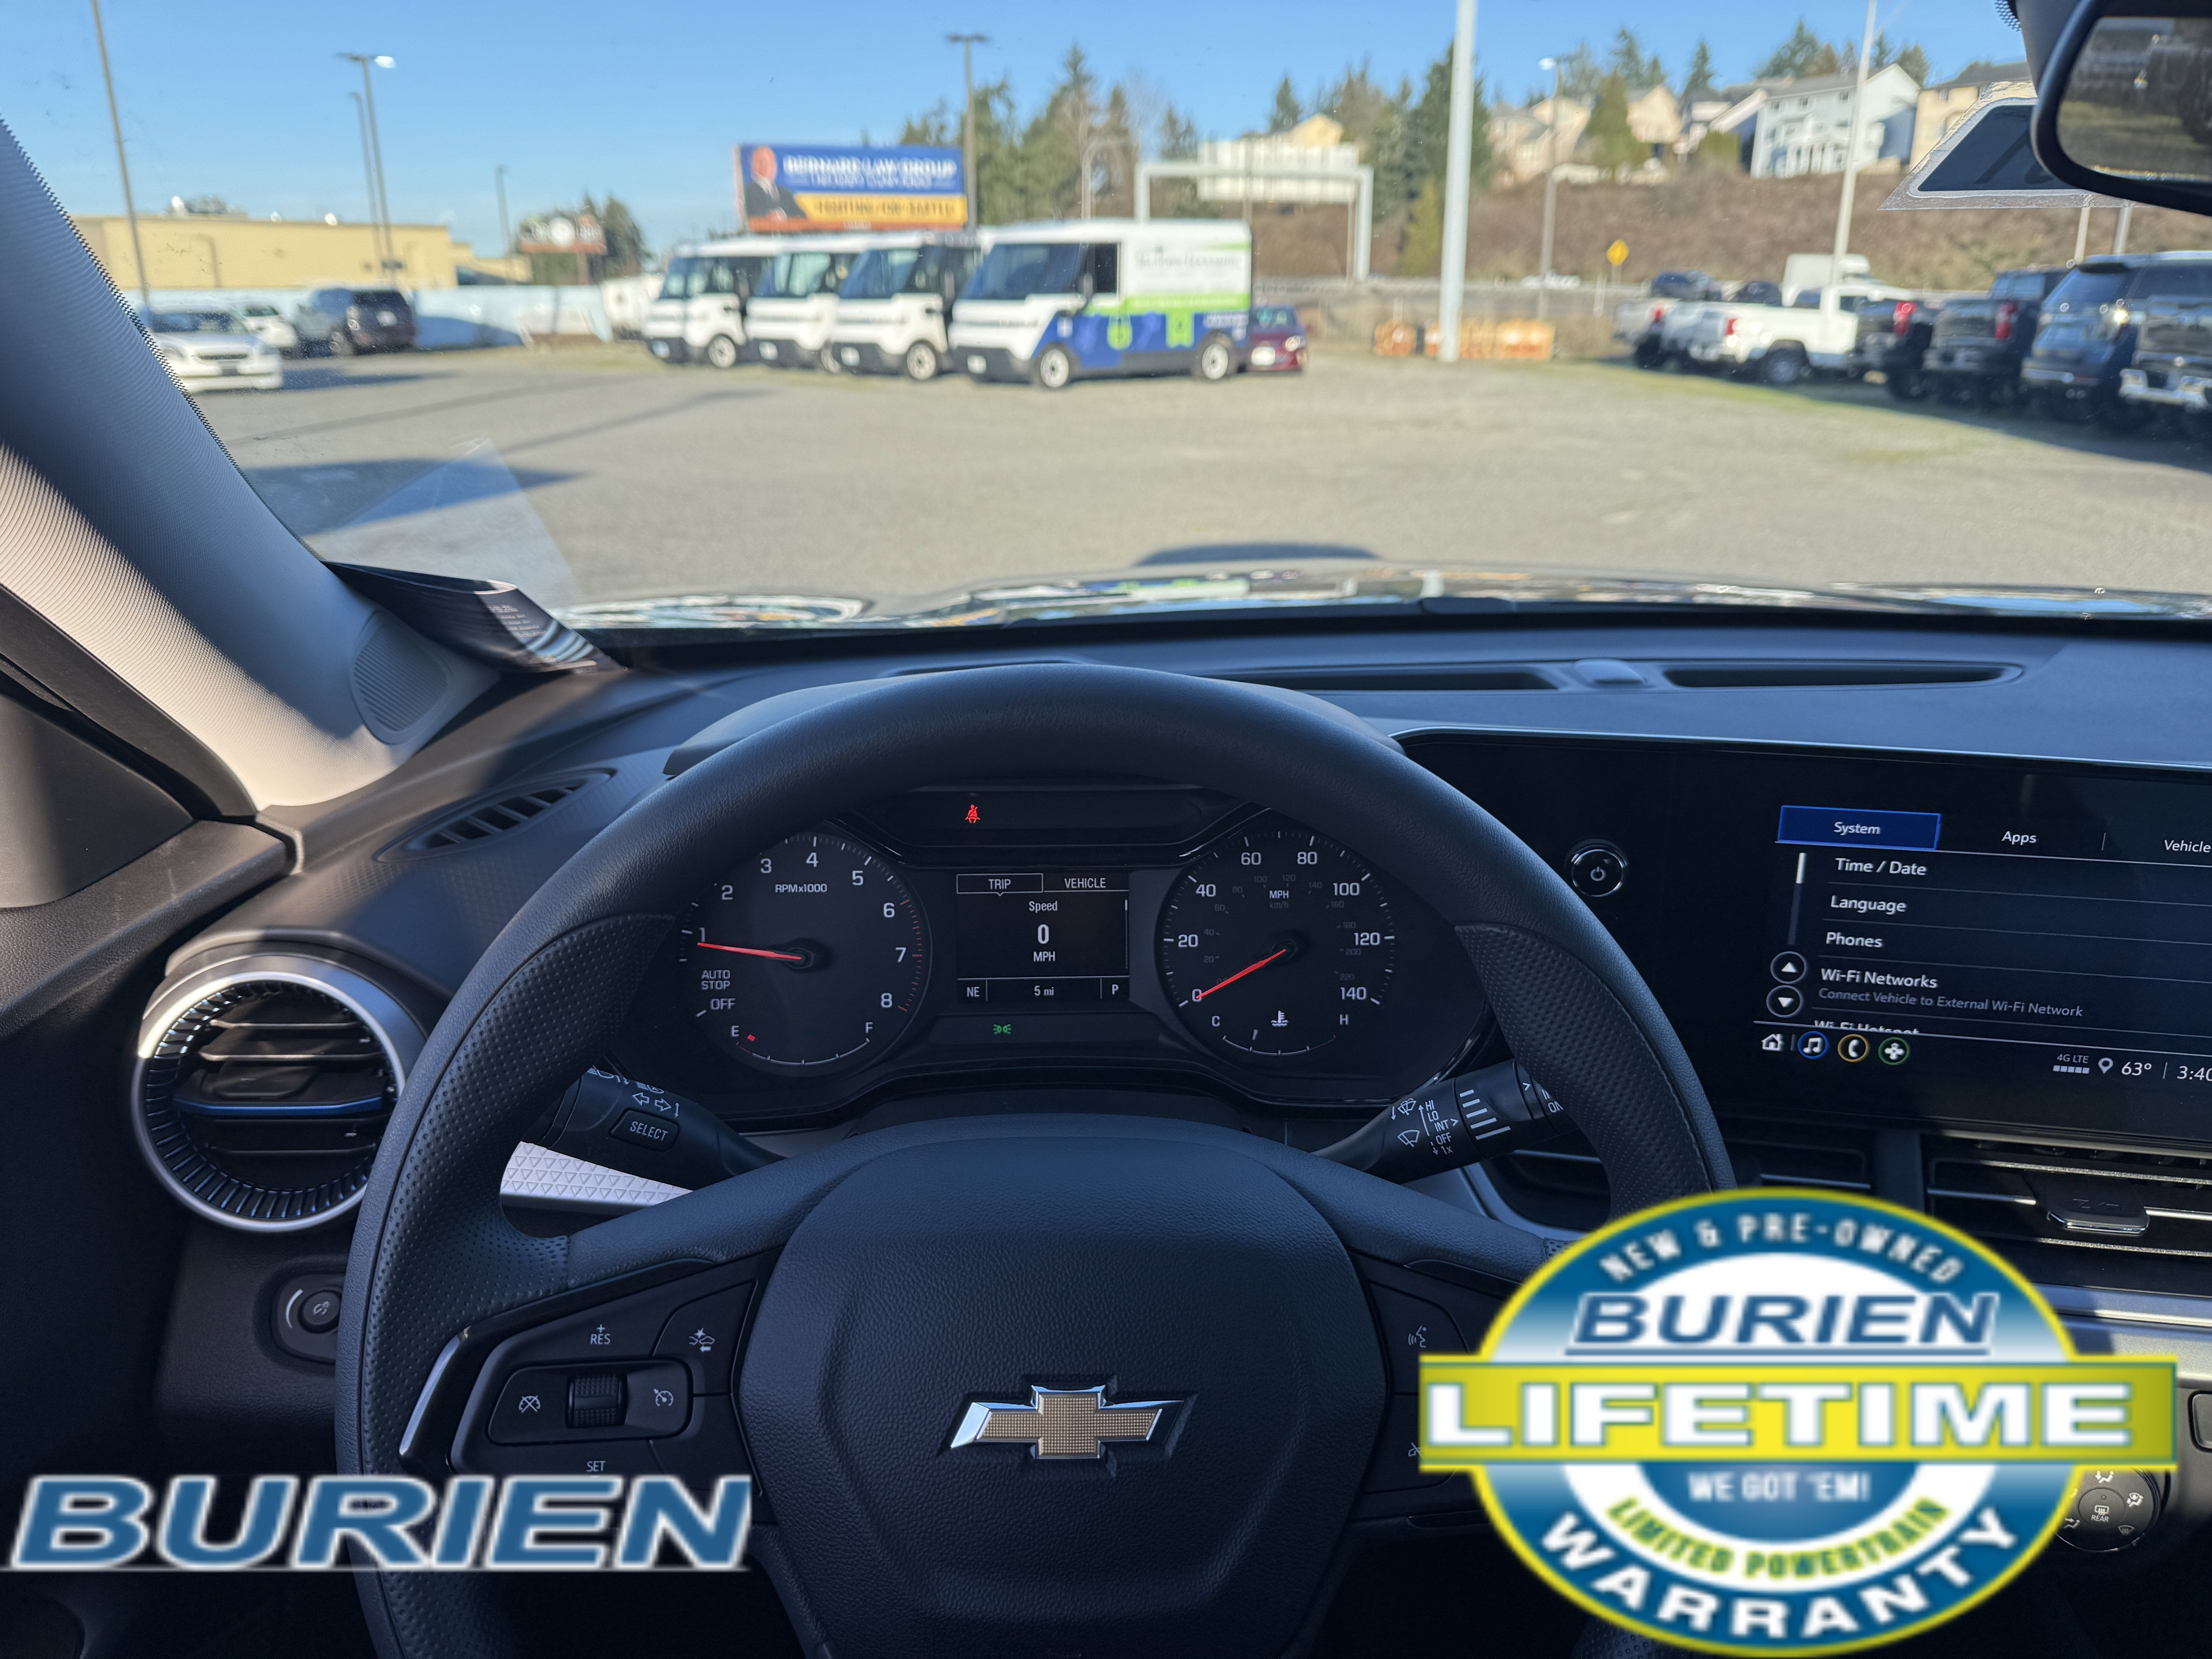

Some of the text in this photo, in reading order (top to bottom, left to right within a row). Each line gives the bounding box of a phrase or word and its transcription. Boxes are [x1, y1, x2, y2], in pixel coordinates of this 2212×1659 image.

[1834, 821, 1881, 835] System
[2002, 831, 2037, 845] Apps
[2164, 840, 2211, 852] Vehicle
[806, 853, 818, 867] 4
[1241, 852, 1261, 865] 60
[1297, 852, 1317, 864] 80
[761, 858, 771, 873] 3
[1835, 858, 1927, 875] Time / Date
[852, 871, 864, 885] 5
[989, 879, 1011, 889] TRIP
[1065, 878, 1106, 888] VEHICLE
[721, 885, 733, 900] 2
[775, 884, 827, 892] RPMx1000
[1196, 884, 1216, 897] 40
[1333, 883, 1360, 896] 100
[1269, 891, 1289, 899] MPH
[883, 903, 895, 917] 6
[1029, 901, 1058, 913] Speed
[1831, 896, 1906, 915] Language
[700, 928, 705, 942] 1
[1037, 924, 1049, 944] 0
[1354, 933, 1380, 945] 120
[1178, 934, 1198, 947] 20
[1826, 933, 1883, 948] Phones
[896, 947, 906, 962] 7
[1034, 952, 1055, 962] MPH
[701, 970, 730, 979] AUTO
[1821, 969, 1938, 988] Wi-Fi Networks
[701, 981, 730, 990] STOP
[967, 987, 979, 996] NE
[1034, 986, 1054, 995] 5 mi
[1112, 985, 1118, 994] P
[881, 993, 892, 1007] 8
[1192, 989, 1202, 1002] 0
[1340, 988, 1366, 1000] 140
[710, 998, 735, 1010] OFF
[1819, 989, 2083, 1017] Connect Vehicle to External Wi-Fi Network
[1212, 1015, 1220, 1026] C
[1340, 1015, 1348, 1025] H
[731, 1026, 739, 1037] E
[866, 1022, 873, 1033] F
[2121, 1062, 2152, 1075] 63°
[2177, 1066, 2212, 1081] 3:40
[1425, 1100, 1434, 1110] HI
[1427, 1111, 1439, 1121] LO
[630, 1121, 668, 1141] SELECT
[1434, 1120, 1448, 1132] INT
[1436, 1133, 1451, 1145] OFF
[1441, 1146, 1453, 1154] 1x
[590, 1333, 610, 1345] RES
[587, 1461, 606, 1472] SET
